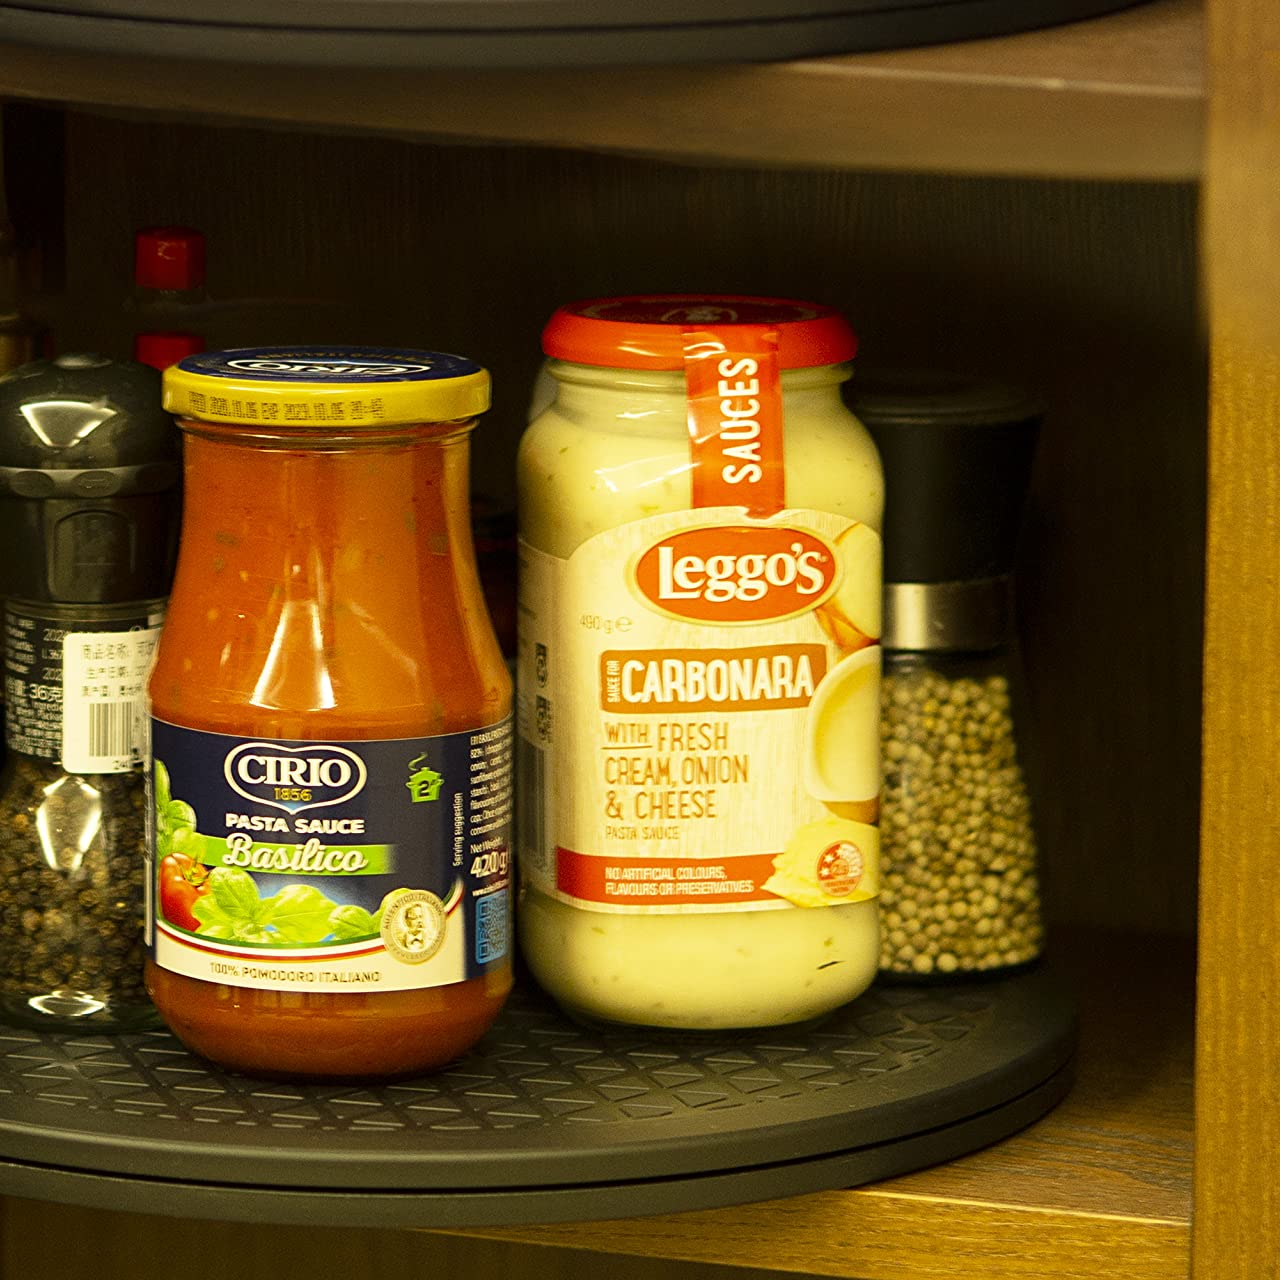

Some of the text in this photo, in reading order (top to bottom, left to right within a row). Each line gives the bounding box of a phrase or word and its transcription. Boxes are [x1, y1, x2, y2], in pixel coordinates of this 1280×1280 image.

[718, 358, 763, 484] SAUCES
[658, 542, 826, 602] Leggo's
[607, 659, 621, 703] SAUCE FOR
[622, 655, 814, 704] CARBONARA
[603, 721, 729, 752] WITH FRESH
[237, 754, 354, 788] CIRIO
[605, 754, 750, 788] CREAM, ONION
[273, 786, 313, 803] 1856
[419, 782, 430, 798] 2
[605, 789, 717, 821] & CHEESE
[225, 813, 366, 835] PASTA SAUCE
[605, 825, 680, 840] PASTA SAUCE
[222, 832, 369, 873] Basilico
[605, 867, 621, 880] NO
[621, 866, 676, 880] ARTIFICIAL
[605, 881, 658, 896] FLAVOURS
[675, 879, 755, 895] PRESERVATIVES
[209, 961, 381, 984] 100% POMODORO ITALIANO
